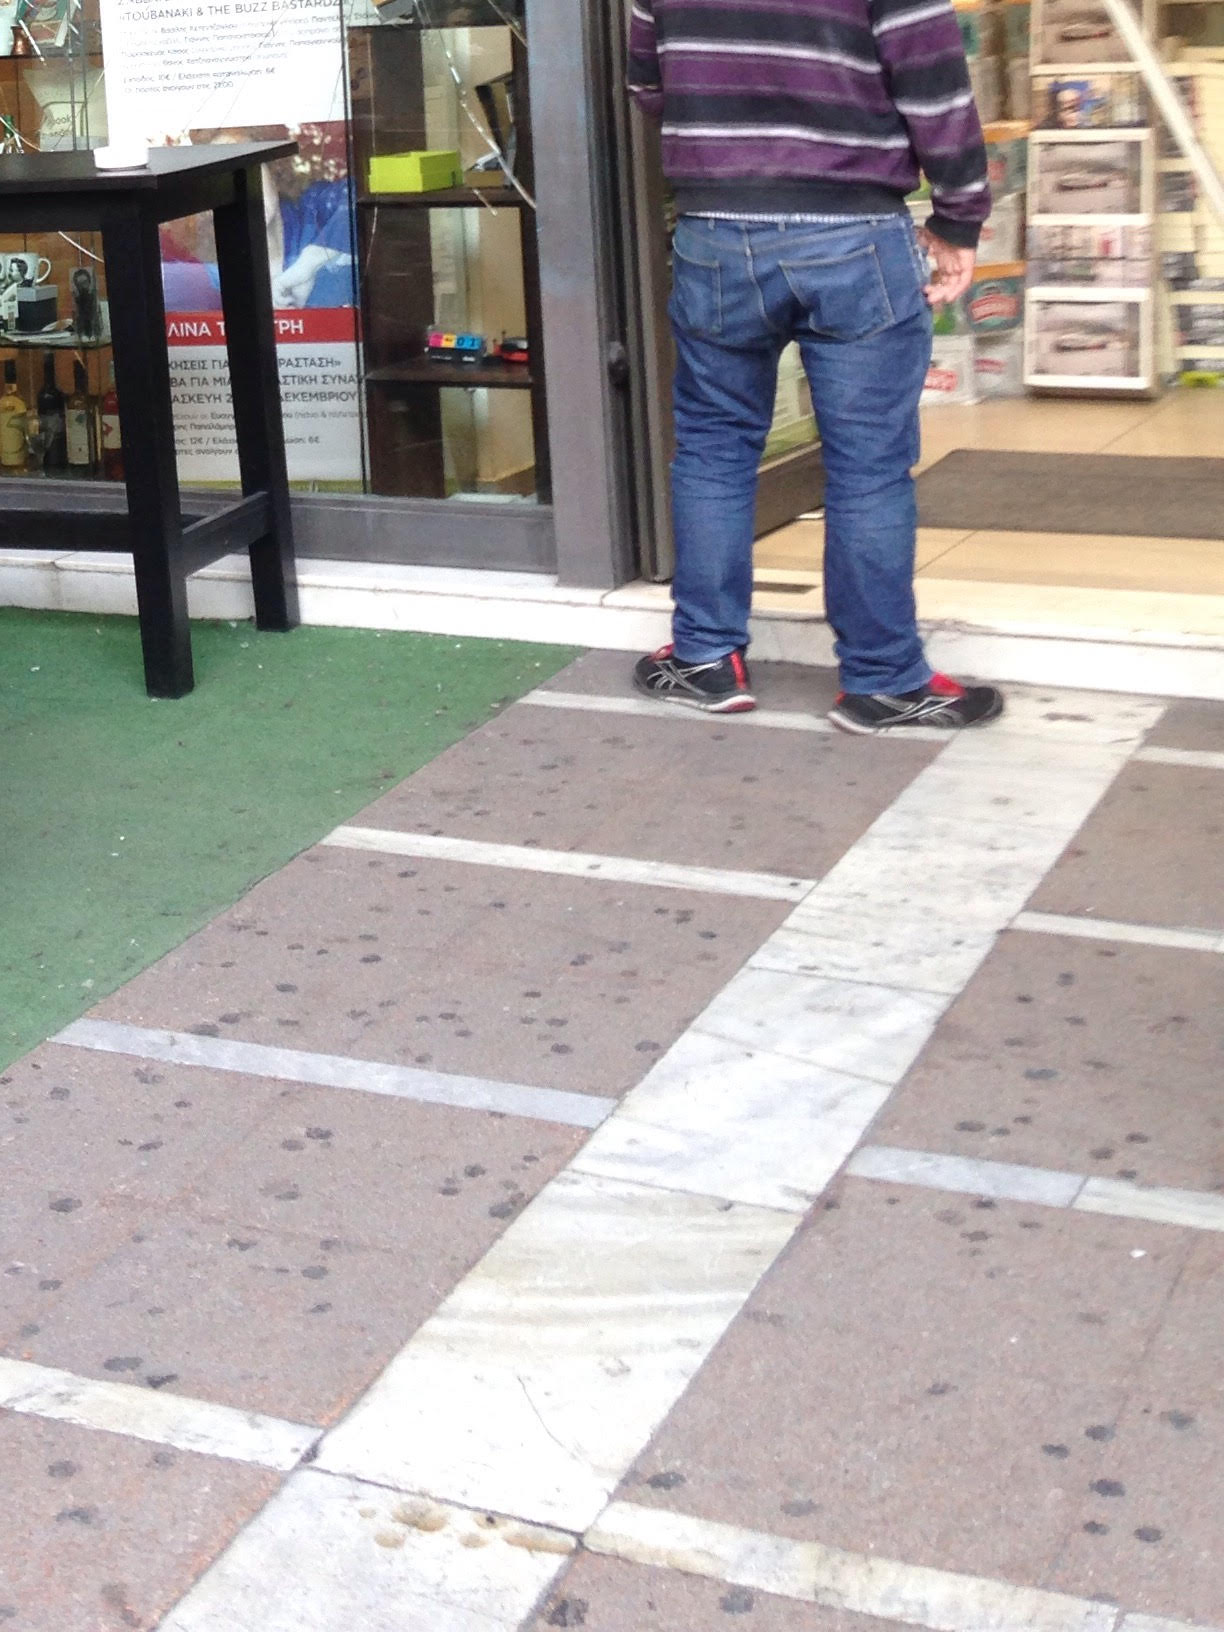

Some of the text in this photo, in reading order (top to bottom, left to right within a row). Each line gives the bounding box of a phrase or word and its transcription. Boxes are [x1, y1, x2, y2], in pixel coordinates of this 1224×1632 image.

[197, 6, 204, 16] &
[208, 4, 231, 16] THE
[235, 1, 267, 14] BUZZ
[168, 320, 211, 337] ΛΙΝΑ
[169, 357, 341, 370] ΚΗΣΕΙΣ ΓΙΑ ΡΑΣΤΑΣΗ»
[191, 377, 211, 387] ΓΙΑ
[173, 393, 222, 405] ΑΣΚΕΥΗ
